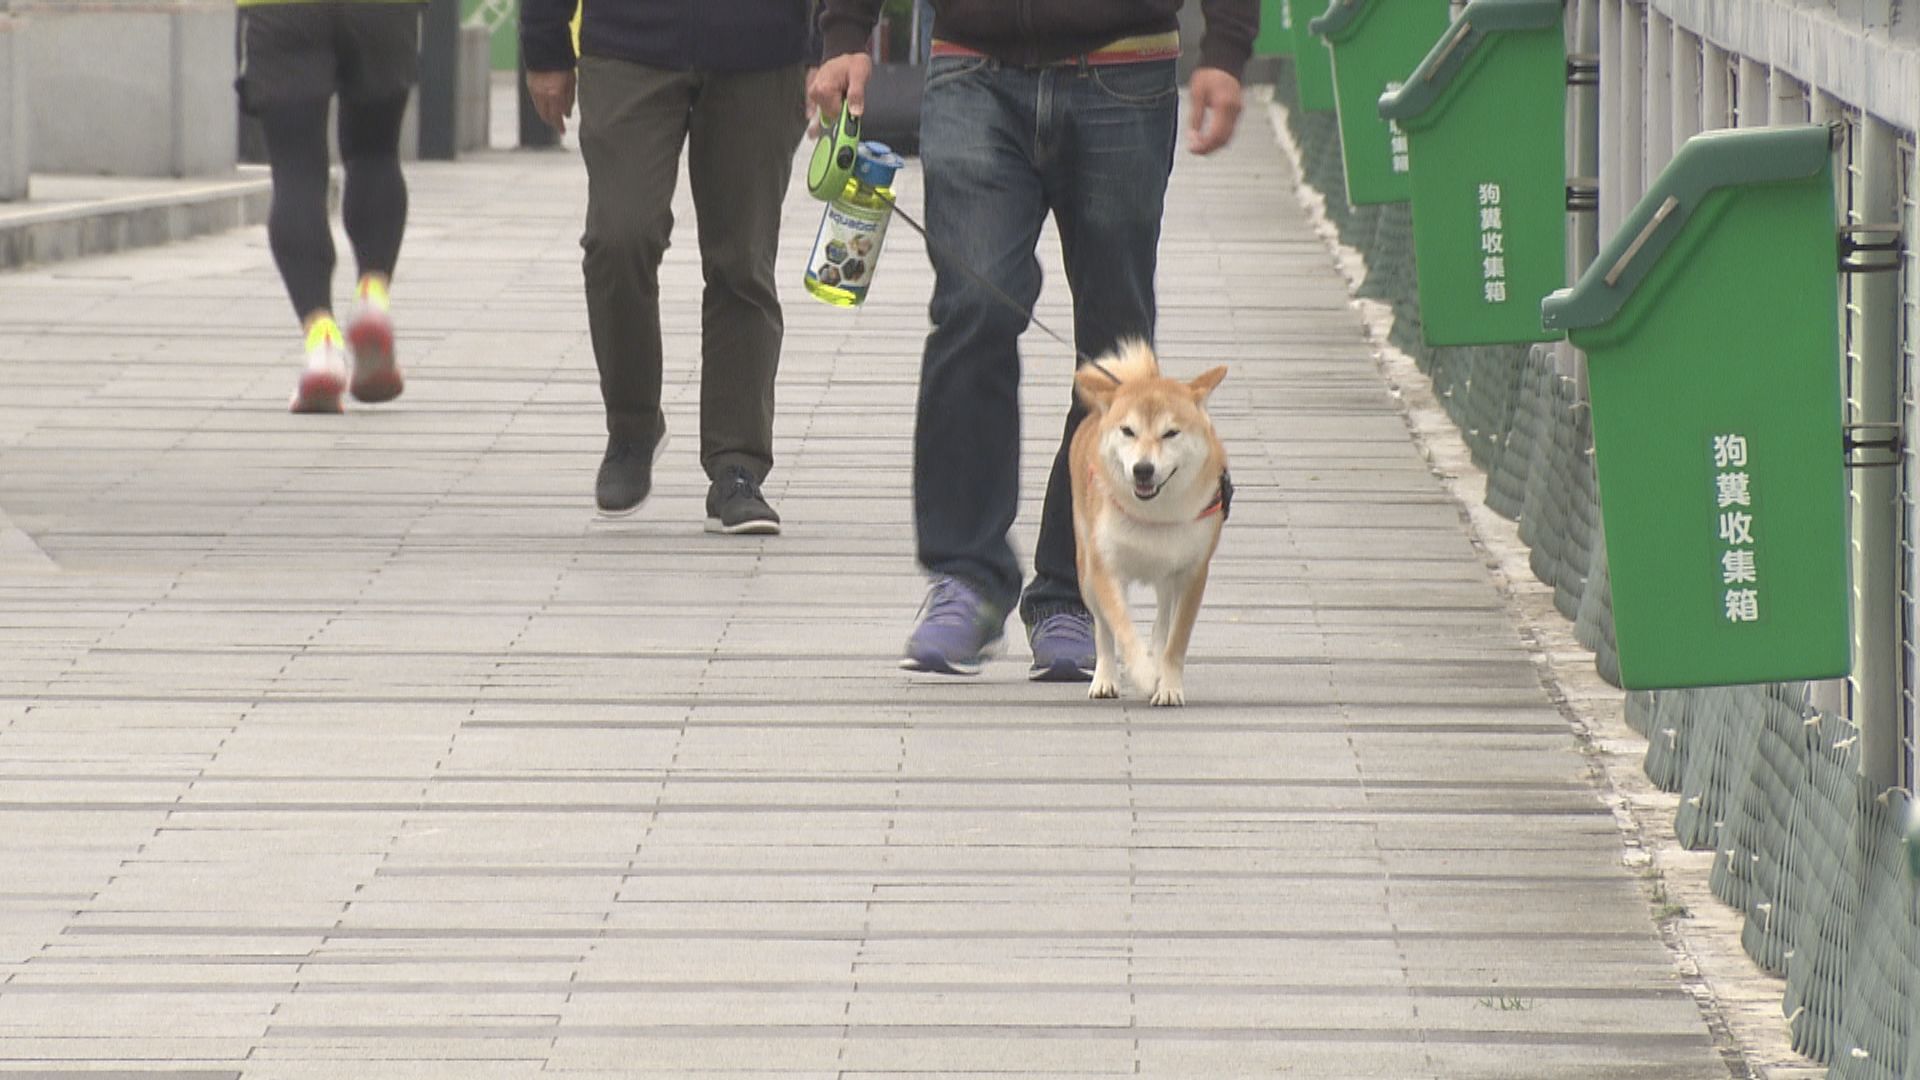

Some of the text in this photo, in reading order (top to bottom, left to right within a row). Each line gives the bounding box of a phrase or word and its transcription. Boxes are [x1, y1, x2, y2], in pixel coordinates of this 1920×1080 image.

[1479, 183, 1506, 303] 狗糞收集箱
[1714, 434, 1759, 623] 狗糞收集箱
